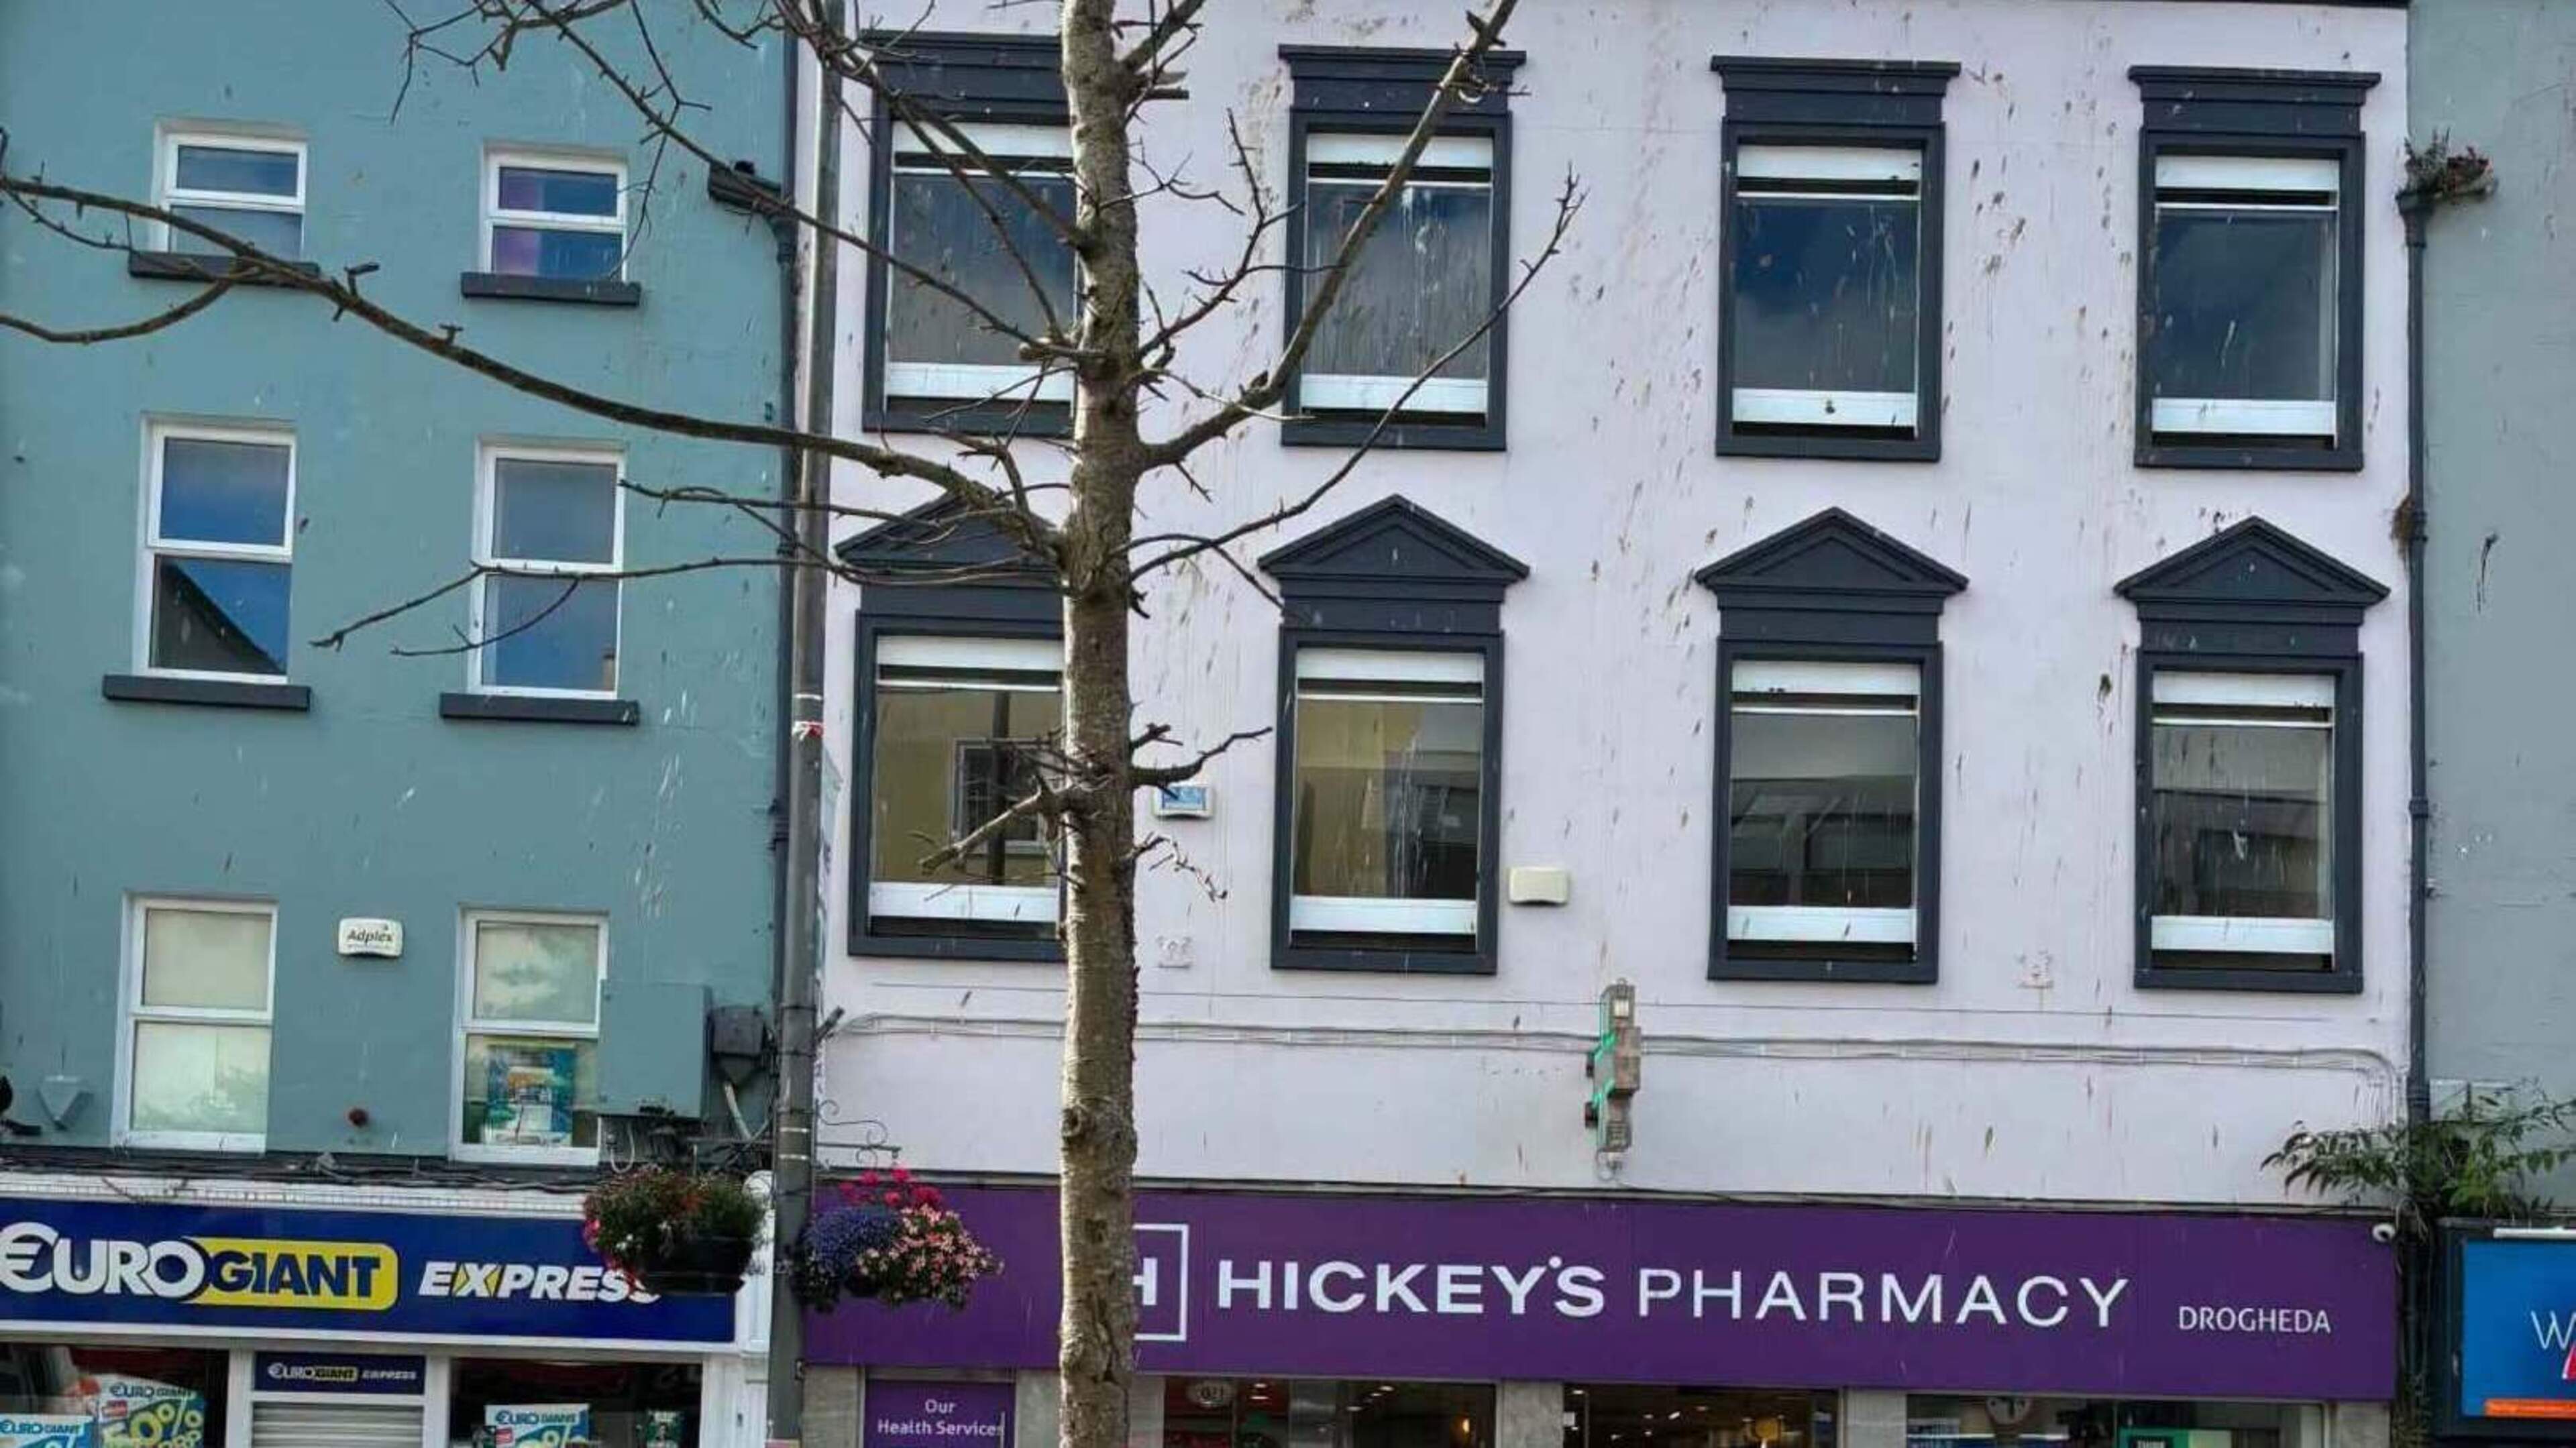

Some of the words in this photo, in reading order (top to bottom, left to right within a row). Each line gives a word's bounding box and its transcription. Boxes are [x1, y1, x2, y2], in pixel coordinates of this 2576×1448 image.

[1218, 1256, 1605, 1317] HICKEY'S
[1638, 1268, 2129, 1328] PHARMACY
[2178, 1305, 2331, 1334] DROGHEDA
[924, 1398, 957, 1414] Our
[877, 1418, 932, 1435] Health
